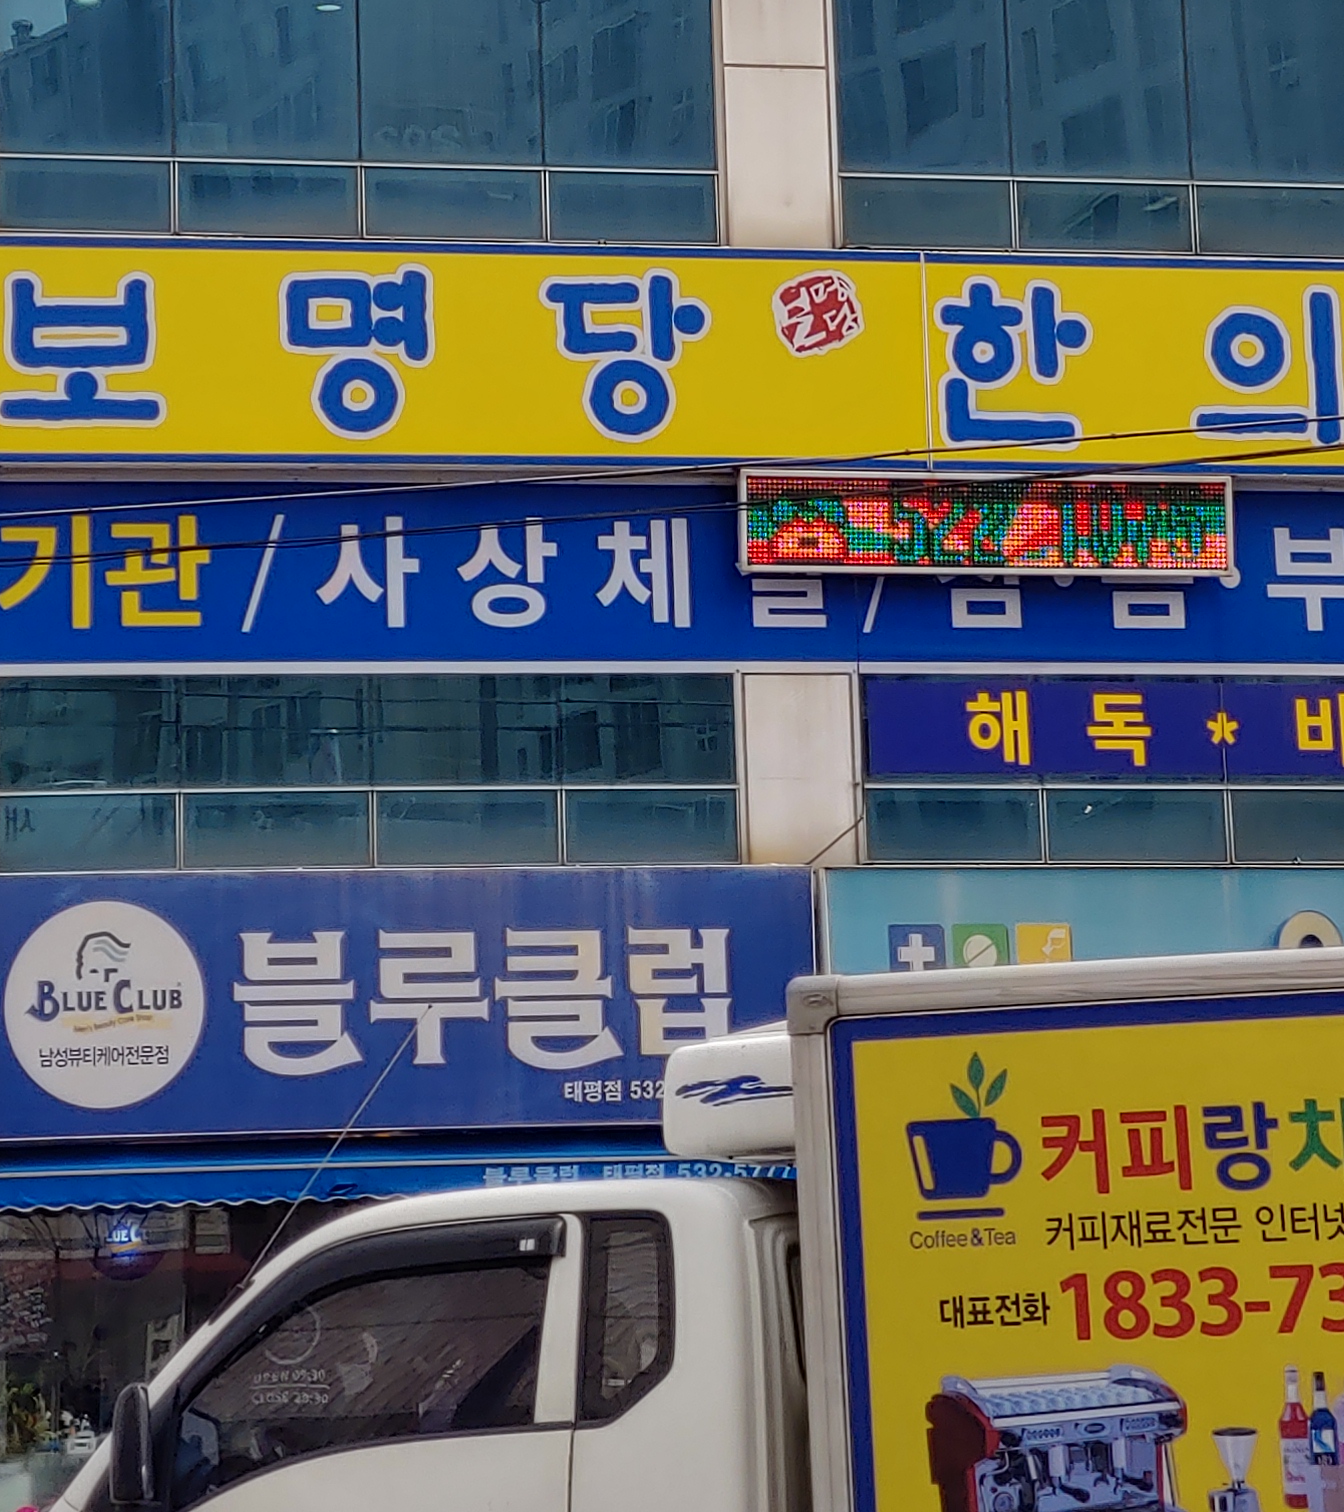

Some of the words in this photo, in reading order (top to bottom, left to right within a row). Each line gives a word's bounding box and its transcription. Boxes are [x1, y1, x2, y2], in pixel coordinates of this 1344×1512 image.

[965, 690, 1154, 768] 해독
[232, 925, 735, 1077] 블루클럽
[38, 1044, 170, 1069] 남성뷰티케어전문점
[562, 1079, 623, 1103] 태평점
[908, 1227, 1017, 1251] Coffee&Tea
[1044, 1205, 1242, 1252] 커피재료전문
[938, 1290, 1051, 1330] 대표전화
